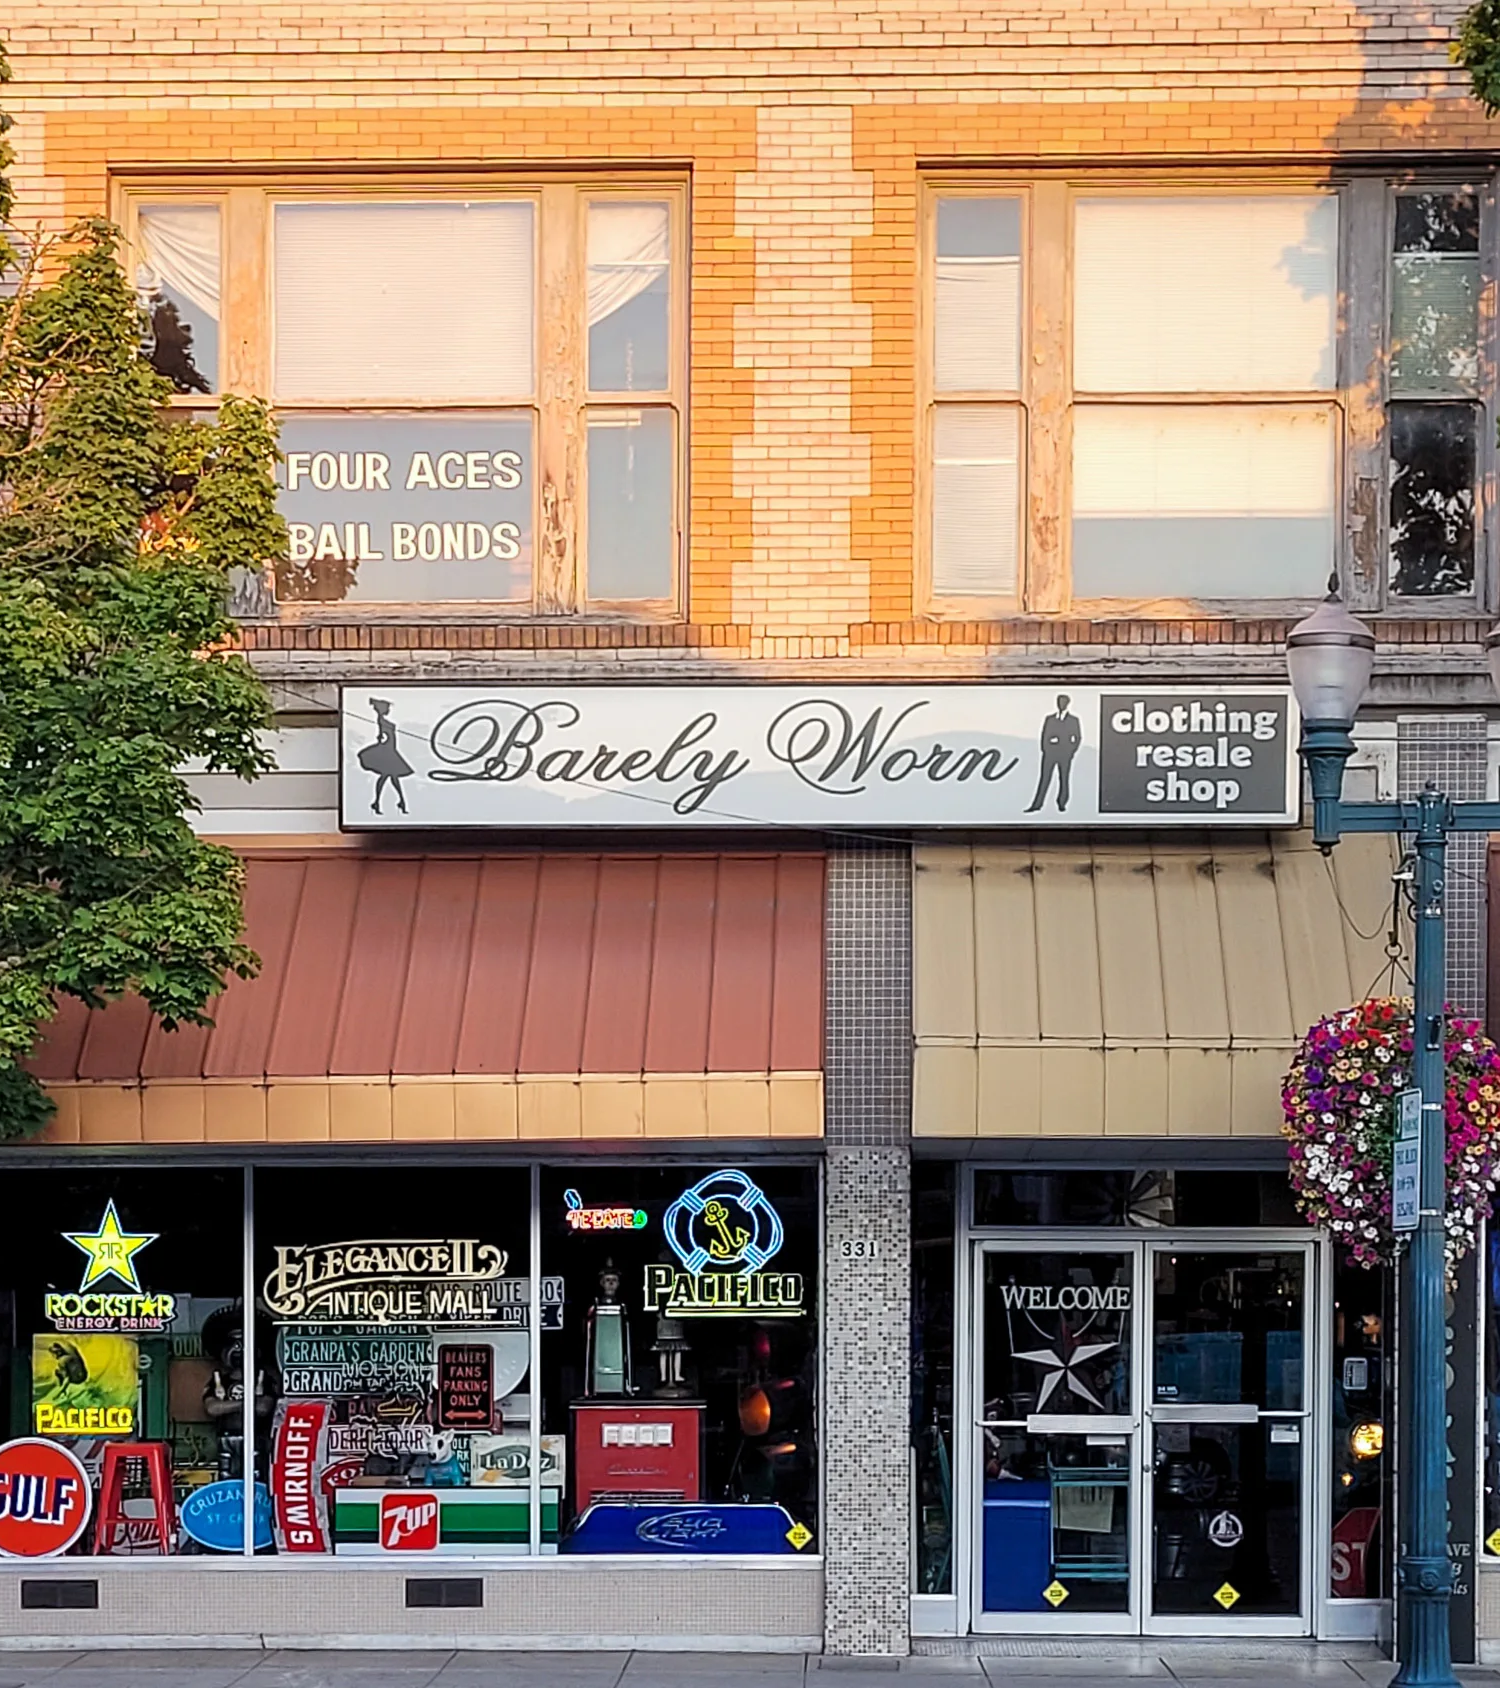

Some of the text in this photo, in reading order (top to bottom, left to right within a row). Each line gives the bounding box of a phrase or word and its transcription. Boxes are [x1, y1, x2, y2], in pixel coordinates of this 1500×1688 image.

[286, 451, 522, 491] FOUR ACES
[288, 521, 522, 562] BAIL BONDS
[1111, 701, 1278, 740] clothing
[427, 699, 1019, 815] Barely Worn
[1136, 736, 1252, 767] resale
[1146, 771, 1240, 809] shop
[842, 1241, 878, 1257] 331
[643, 1264, 804, 1313] PACIFICO
[1001, 1285, 1131, 1311] WELCOME
[306, 1290, 498, 1322] ANTIQUE MALL
[58, 1317, 163, 1329] ENERGY DRINK
[291, 1341, 425, 1361] GRANPA'S GARDEN
[443, 1380, 488, 1393] PARKING
[450, 1366, 482, 1378] FANS
[450, 1395, 482, 1407] ONLY
[383, 1502, 437, 1547] 7UP
